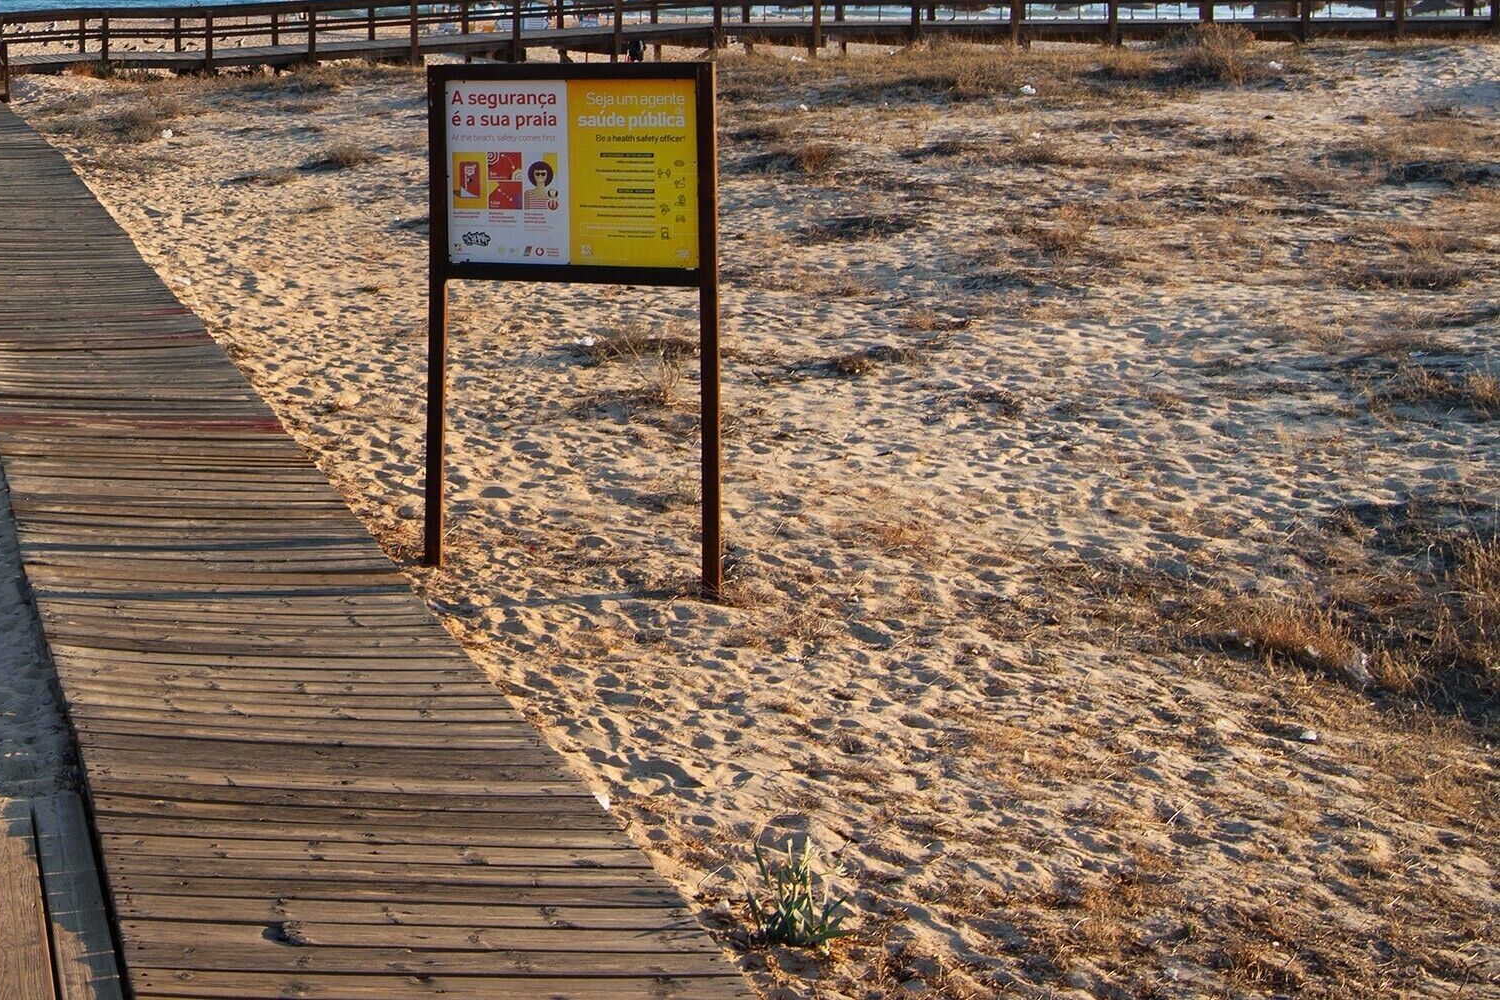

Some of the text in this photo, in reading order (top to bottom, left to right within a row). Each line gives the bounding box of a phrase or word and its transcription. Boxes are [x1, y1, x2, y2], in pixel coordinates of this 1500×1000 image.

[451, 90, 557, 109] A segurança
[587, 91, 685, 109] Seja um agente
[451, 110, 557, 130] é a sua praia
[579, 109, 686, 131] saúde pública
[595, 134, 606, 142] Be
[613, 134, 635, 142] health
[636, 134, 658, 143] safety
